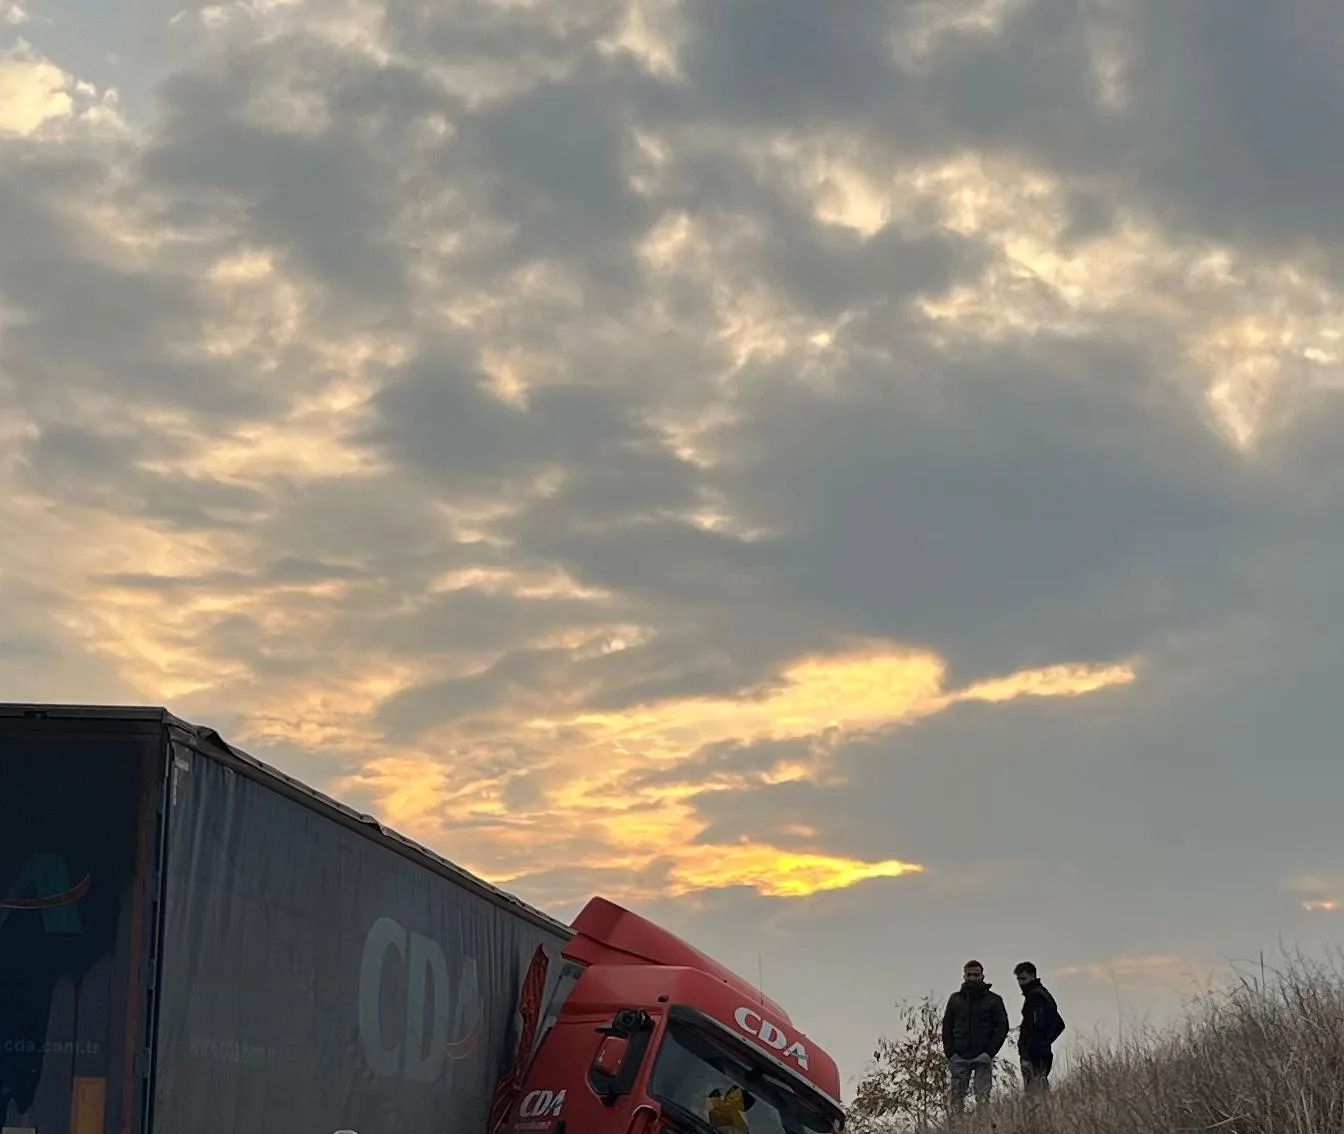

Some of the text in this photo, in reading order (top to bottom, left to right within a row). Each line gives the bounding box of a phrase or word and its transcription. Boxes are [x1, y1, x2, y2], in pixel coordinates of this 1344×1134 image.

[358, 916, 482, 1085] CDA
[734, 1007, 809, 1071] CDA
[519, 1089, 567, 1118] CDA
